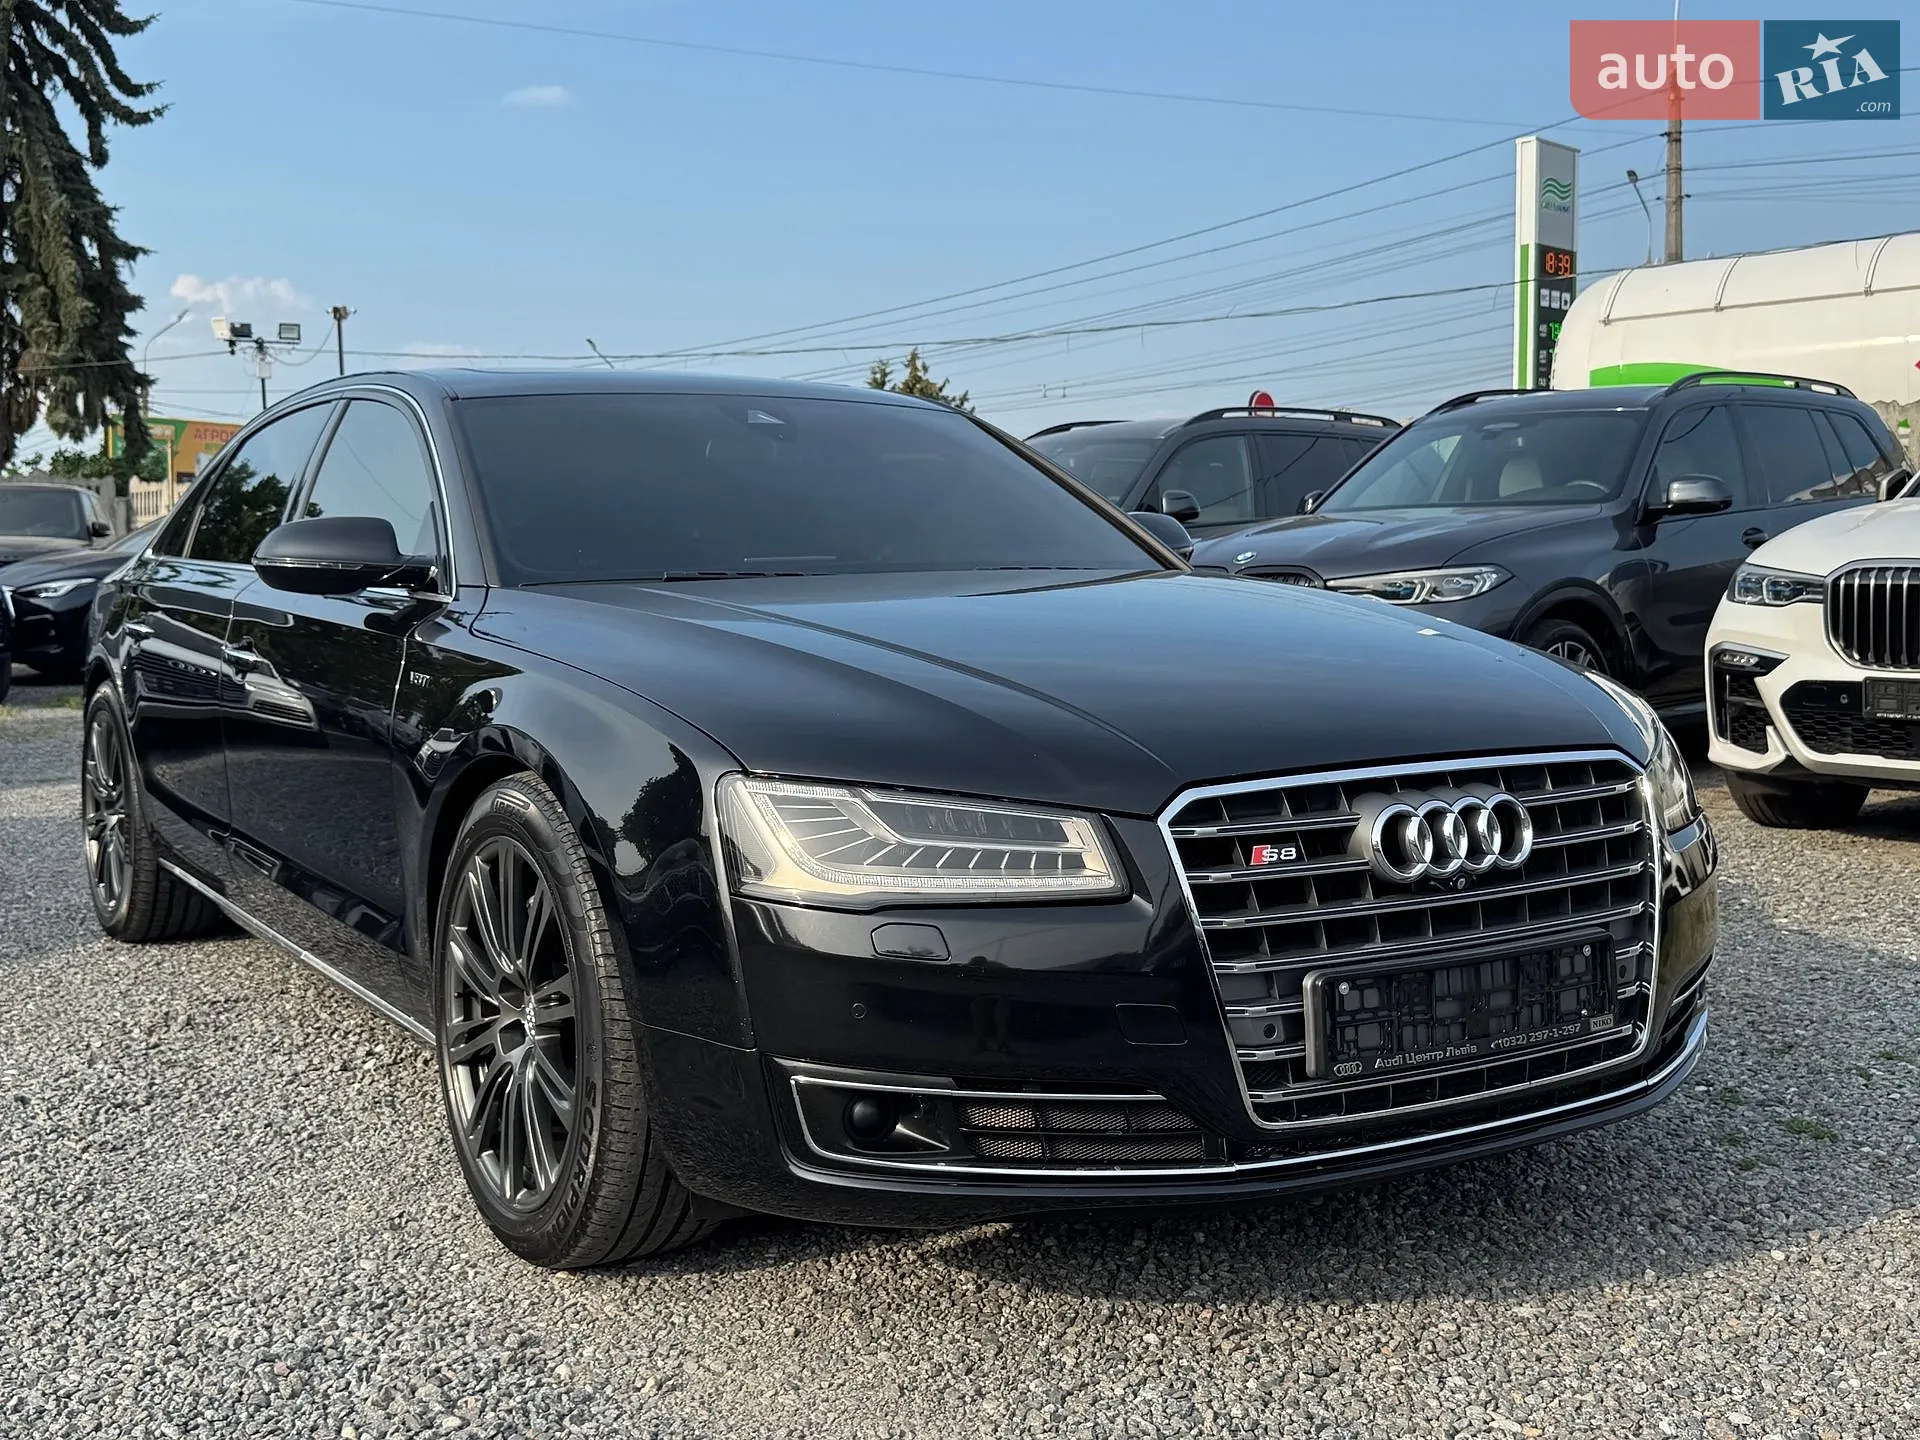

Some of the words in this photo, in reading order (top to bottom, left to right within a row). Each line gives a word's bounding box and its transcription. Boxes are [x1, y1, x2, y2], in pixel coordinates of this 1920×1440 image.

[1545, 252, 1571, 277] 18:39
[1260, 847, 1297, 862] S8
[1591, 1017, 1613, 1029] NIKO
[1374, 1055, 1403, 1069] Audi
[1405, 1050, 1444, 1065] Центр
[1498, 1033, 1528, 1049] (032)
[1528, 1023, 1581, 1043] 297-1-297
